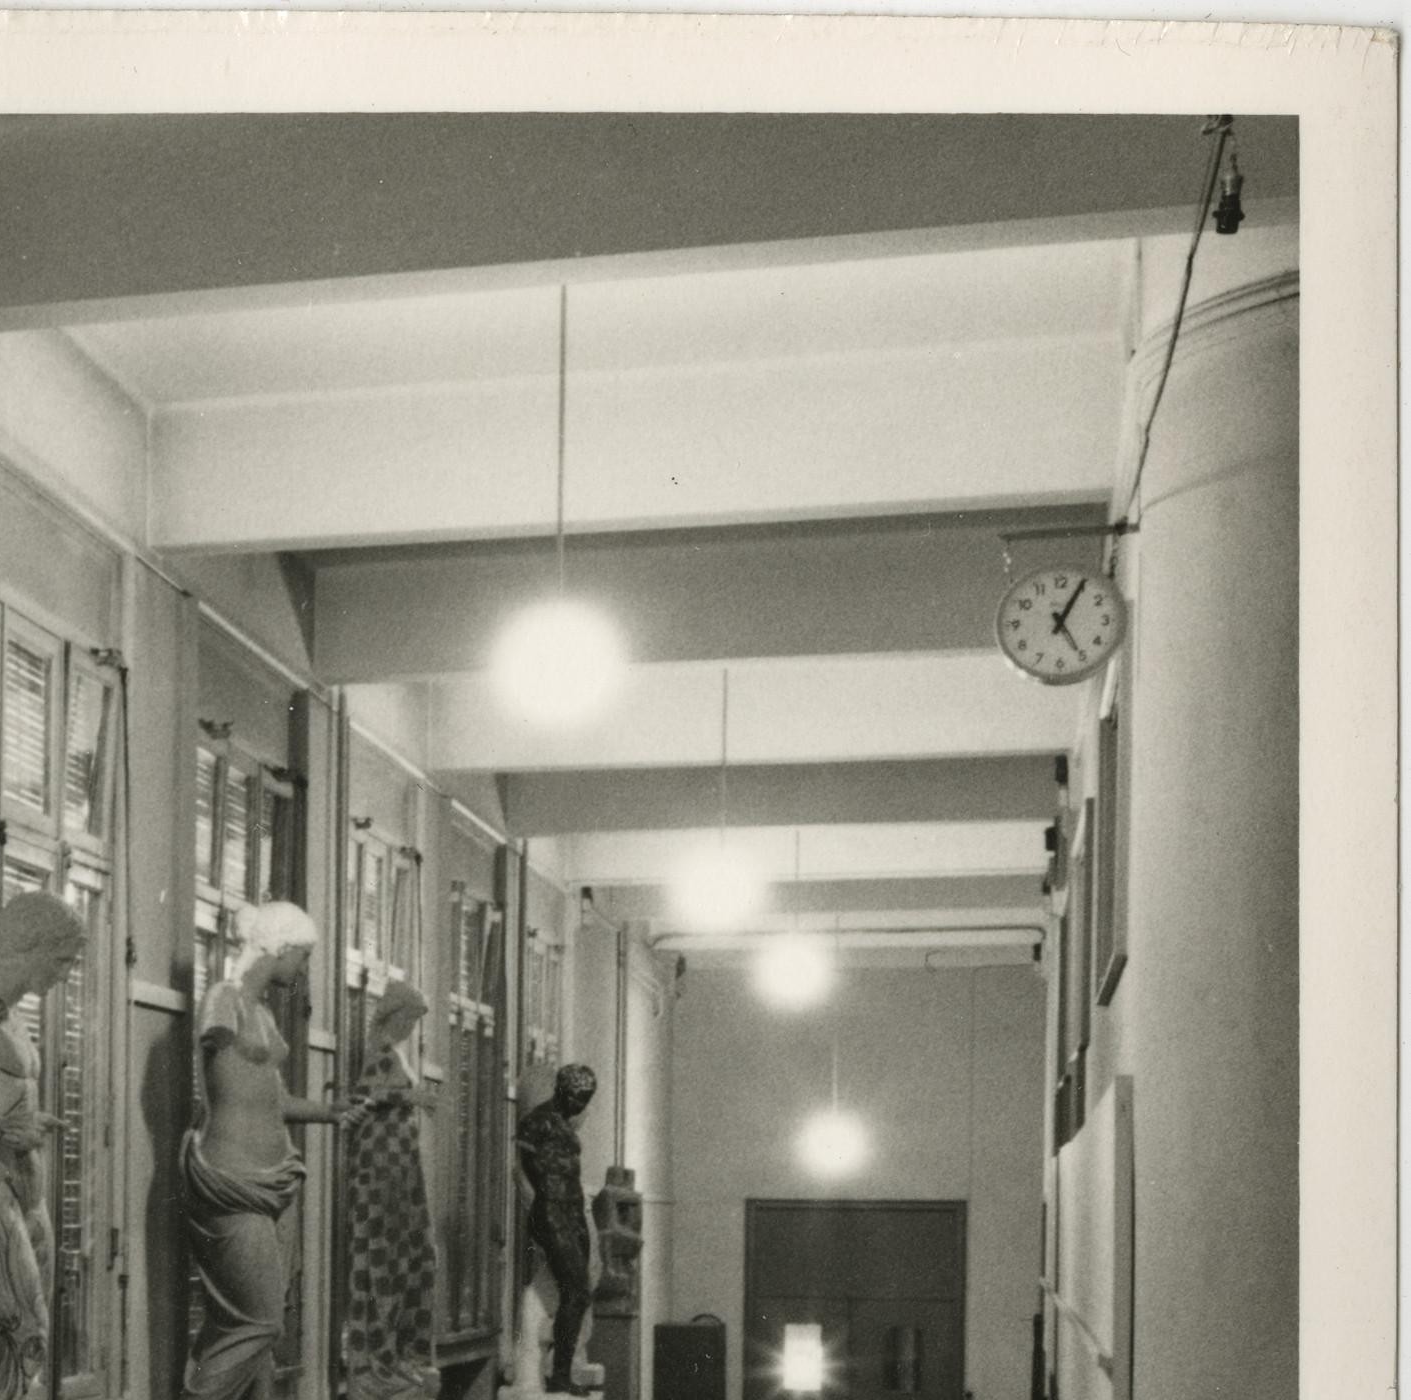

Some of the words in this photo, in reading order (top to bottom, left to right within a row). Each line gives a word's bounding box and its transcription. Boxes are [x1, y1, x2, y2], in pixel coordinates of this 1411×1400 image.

[1034, 582, 1045, 596] 11
[1054, 576, 1068, 589] 12
[1018, 598, 1033, 611] 10
[1093, 594, 1103, 607] 2
[1101, 614, 1110, 627] 3
[1018, 639, 1027, 651] 8
[1092, 635, 1102, 646] 4
[1035, 652, 1045, 665] 7
[1078, 649, 1087, 662] 5
[1055, 656, 1065, 669] 6
